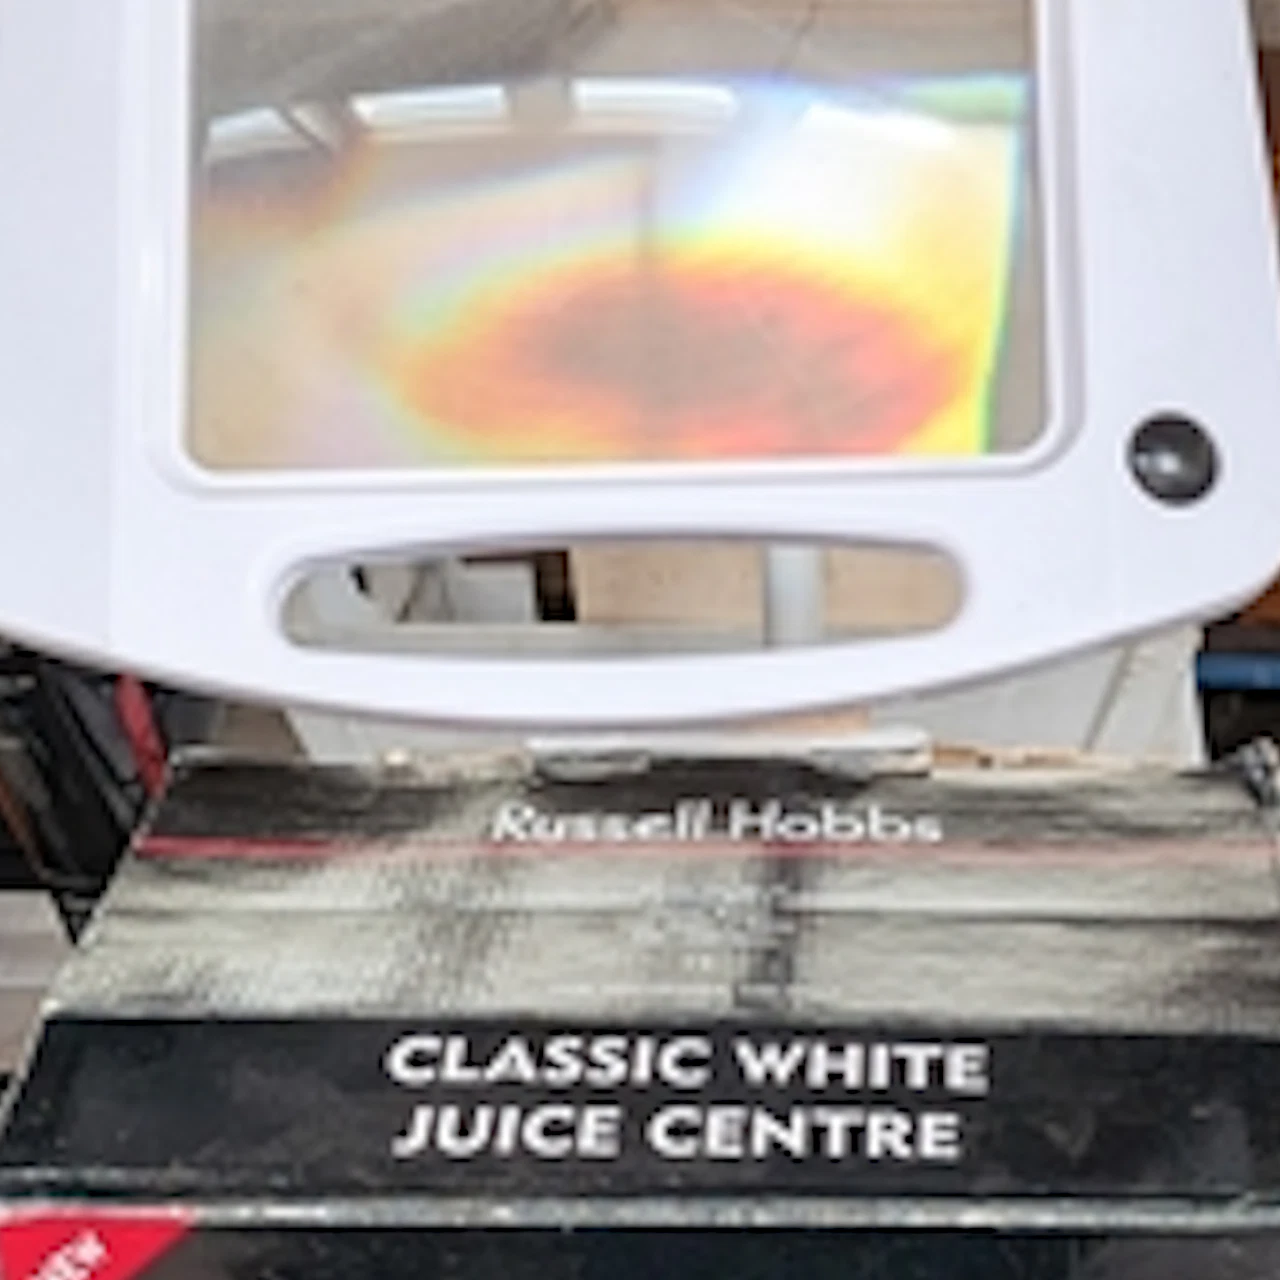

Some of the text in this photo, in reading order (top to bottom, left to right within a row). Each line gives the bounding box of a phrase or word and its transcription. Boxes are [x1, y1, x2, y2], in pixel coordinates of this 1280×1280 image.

[493, 798, 944, 842] Russell Hobbs
[387, 1035, 990, 1092] CLASSIC WHITE
[391, 1104, 962, 1160] JUICE CENTRE
